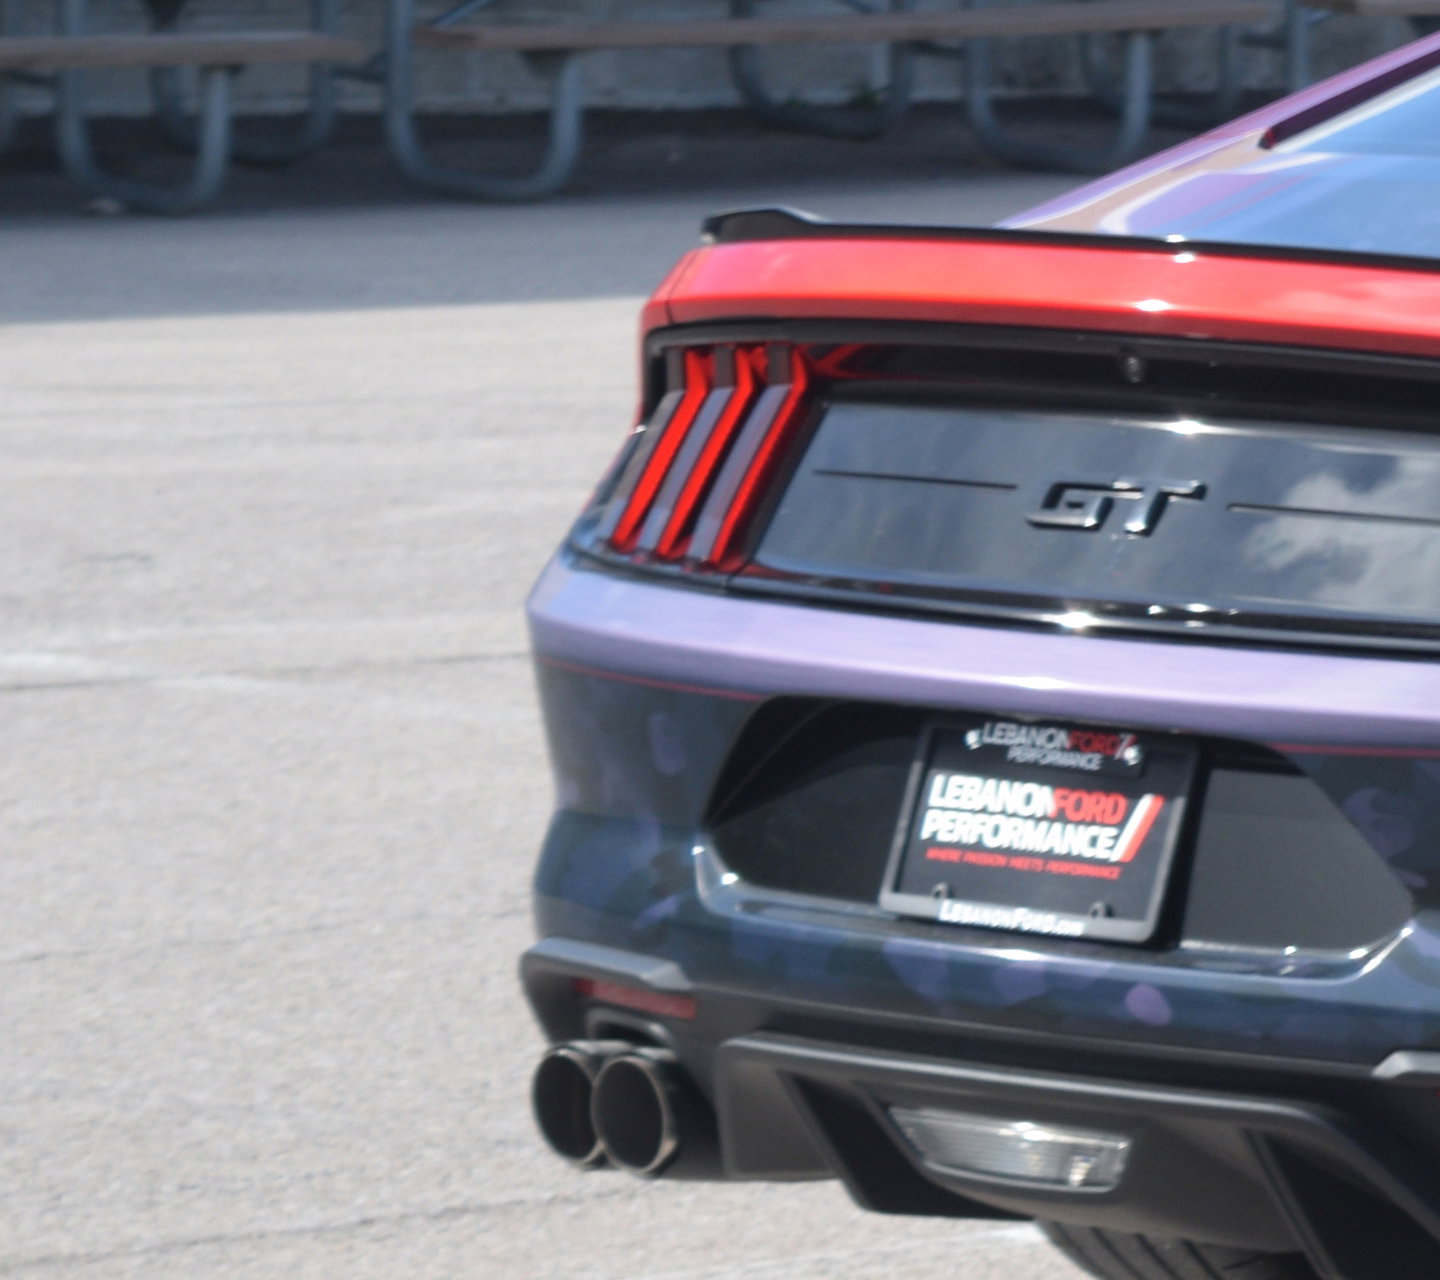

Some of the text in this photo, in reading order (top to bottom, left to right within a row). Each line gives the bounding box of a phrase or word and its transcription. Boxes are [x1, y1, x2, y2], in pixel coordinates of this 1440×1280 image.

[1026, 476, 1209, 537] GT
[928, 773, 1128, 825] LEBANONFORD
[920, 808, 1121, 862] PERFORMANCE
